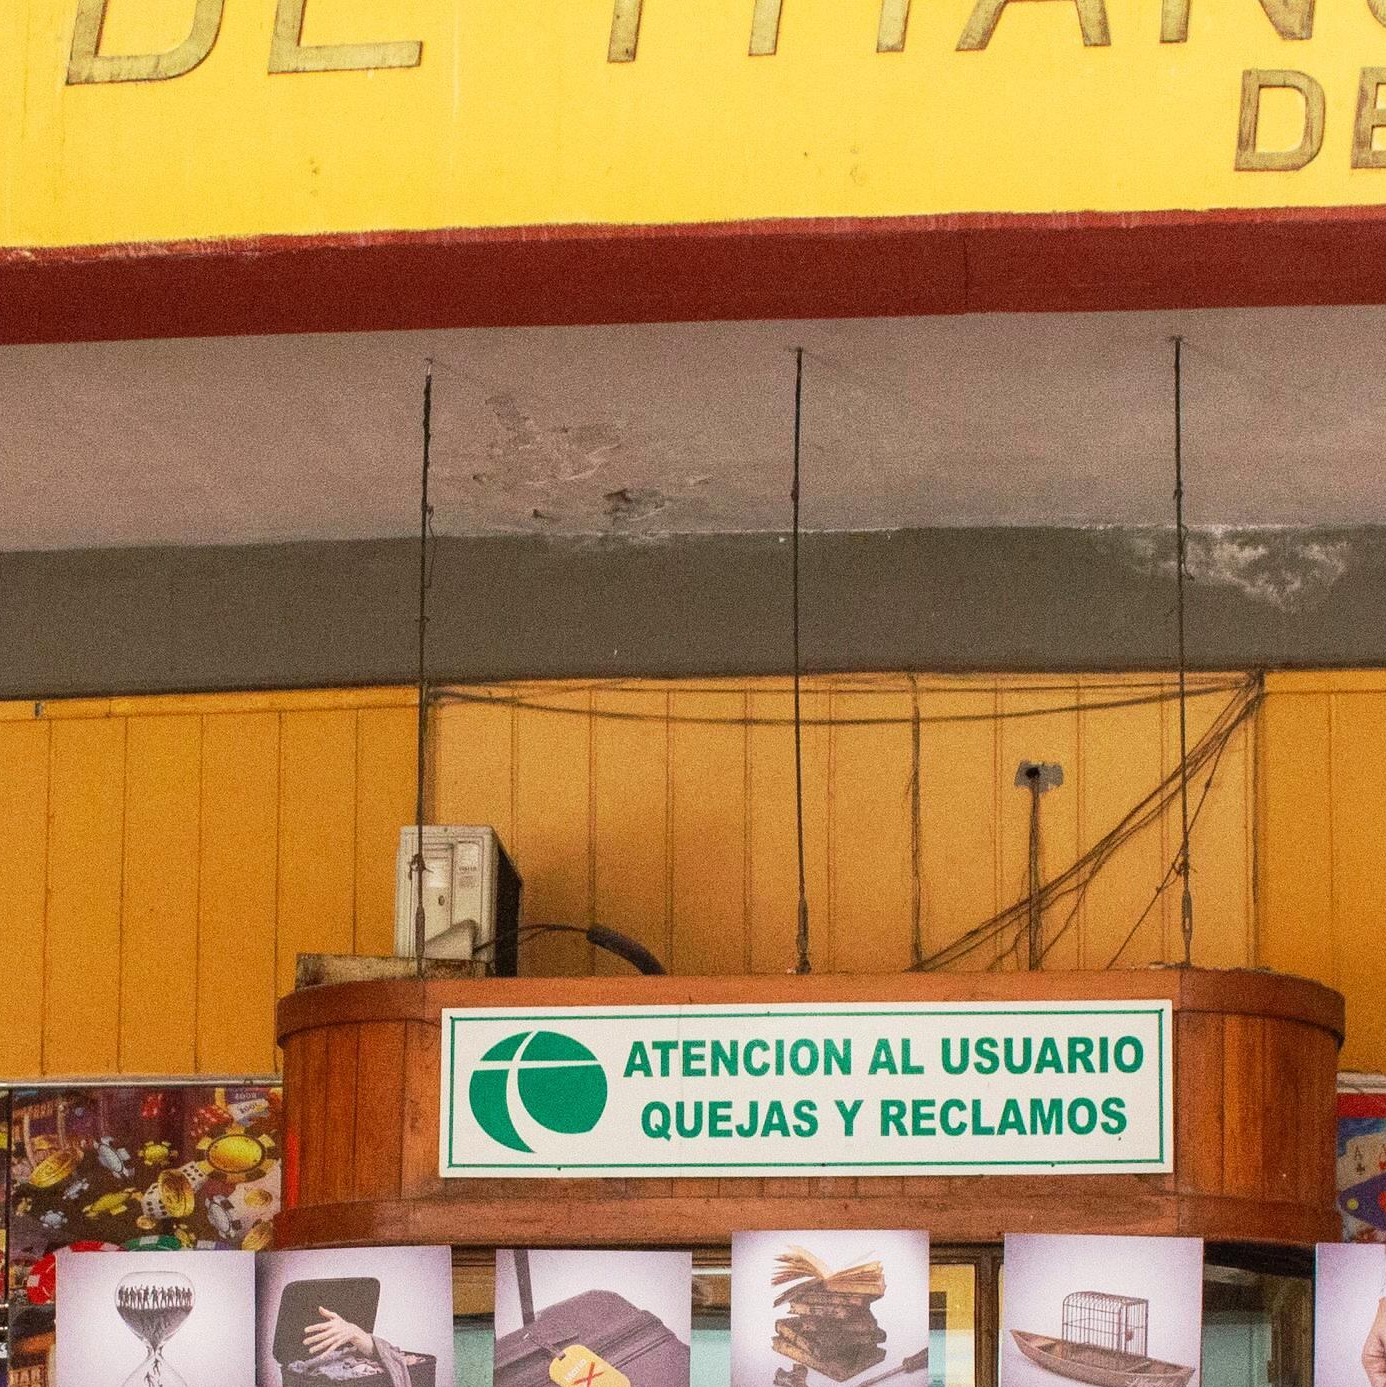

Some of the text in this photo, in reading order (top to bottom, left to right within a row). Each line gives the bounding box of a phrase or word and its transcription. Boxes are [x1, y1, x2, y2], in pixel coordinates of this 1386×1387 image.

[623, 1035, 1146, 1078] ATENCION AL USUARIO
[640, 1096, 1128, 1141] QUEJAS Y RECLAMOS
